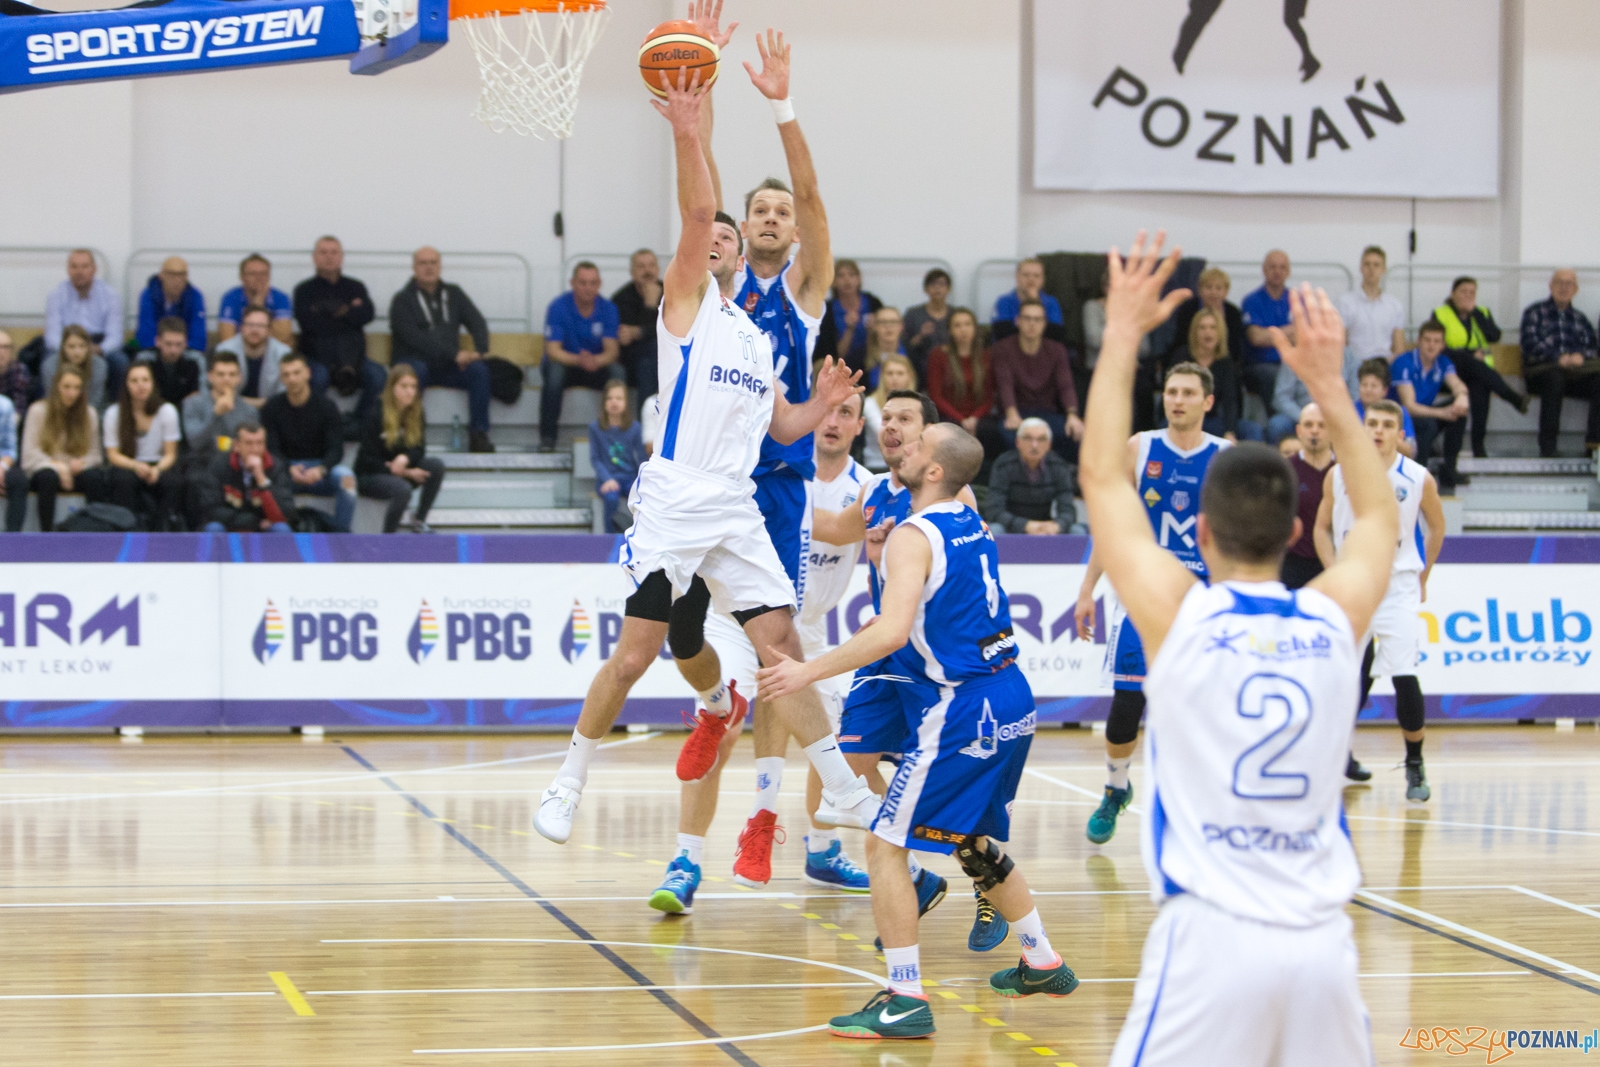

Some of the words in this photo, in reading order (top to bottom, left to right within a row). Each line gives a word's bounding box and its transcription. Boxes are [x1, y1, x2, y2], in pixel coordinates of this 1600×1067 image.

[652, 49, 700, 62] molten
[1092, 65, 1406, 165] POZNAŃ
[738, 331, 757, 364] 11
[289, 596, 378, 610] fundacja
[443, 596, 531, 610] fundacja
[1418, 598, 1592, 643] nclub
[292, 612, 378, 661] PBG
[446, 612, 531, 661] PBG
[40, 656, 113, 673] LEKÓW
[1021, 656, 1083, 671] EKÓW
[1444, 646, 1592, 666] podróży
[1232, 672, 1312, 800] 2
